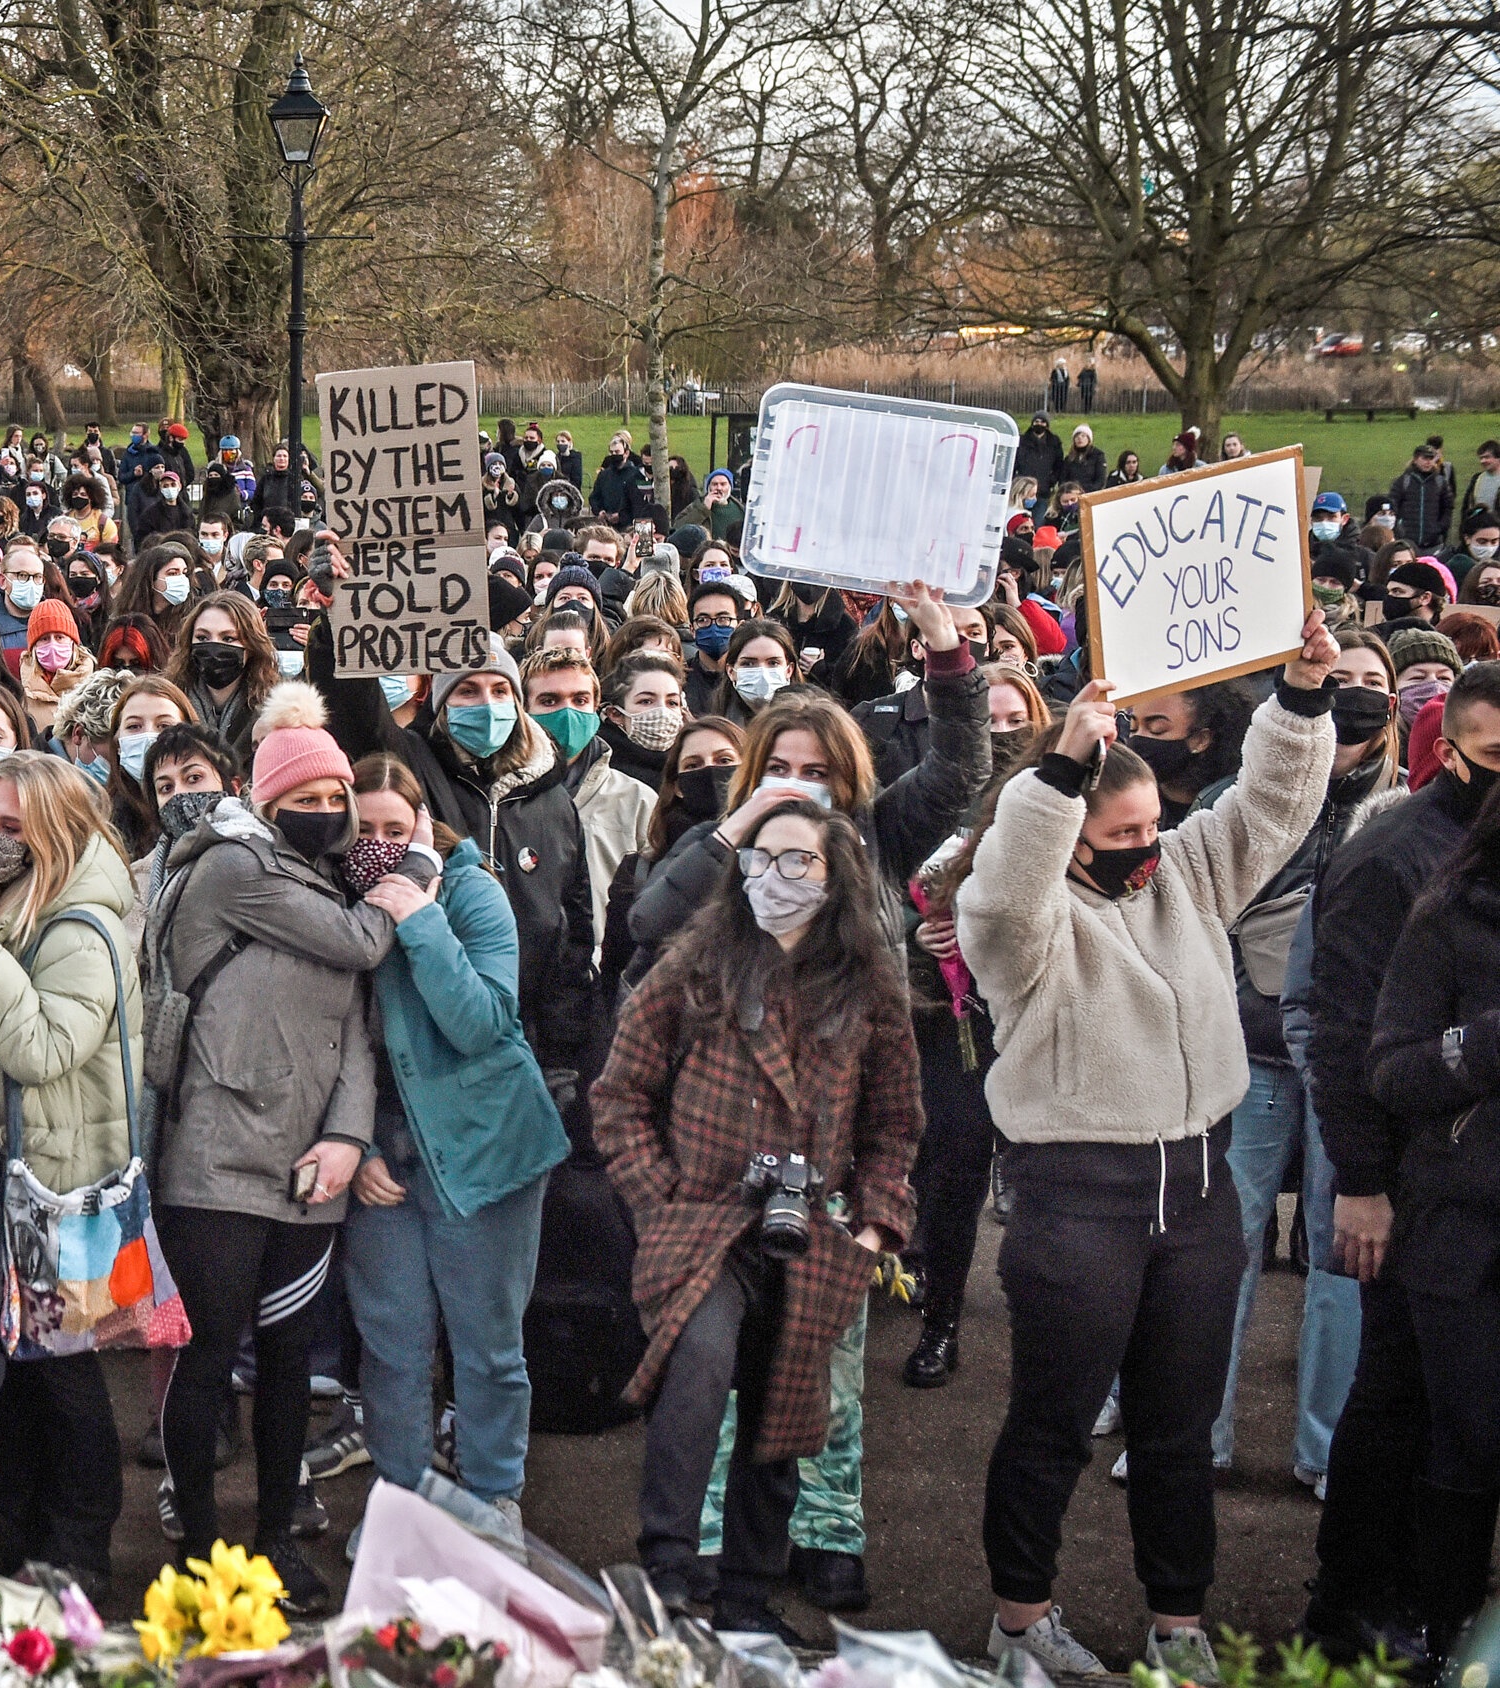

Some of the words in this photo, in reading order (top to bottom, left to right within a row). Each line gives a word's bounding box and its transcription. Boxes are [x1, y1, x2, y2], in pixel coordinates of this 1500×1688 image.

[329, 382, 469, 441] KILLED
[330, 446, 376, 495] BY
[382, 439, 464, 488] THE
[332, 492, 472, 540] SYSTEM
[1097, 489, 1286, 609] EDUCATE
[340, 573, 471, 620] TOLD
[1162, 556, 1239, 615] YOUR
[337, 619, 488, 673] PROTECTS
[1166, 606, 1241, 670] SONS
